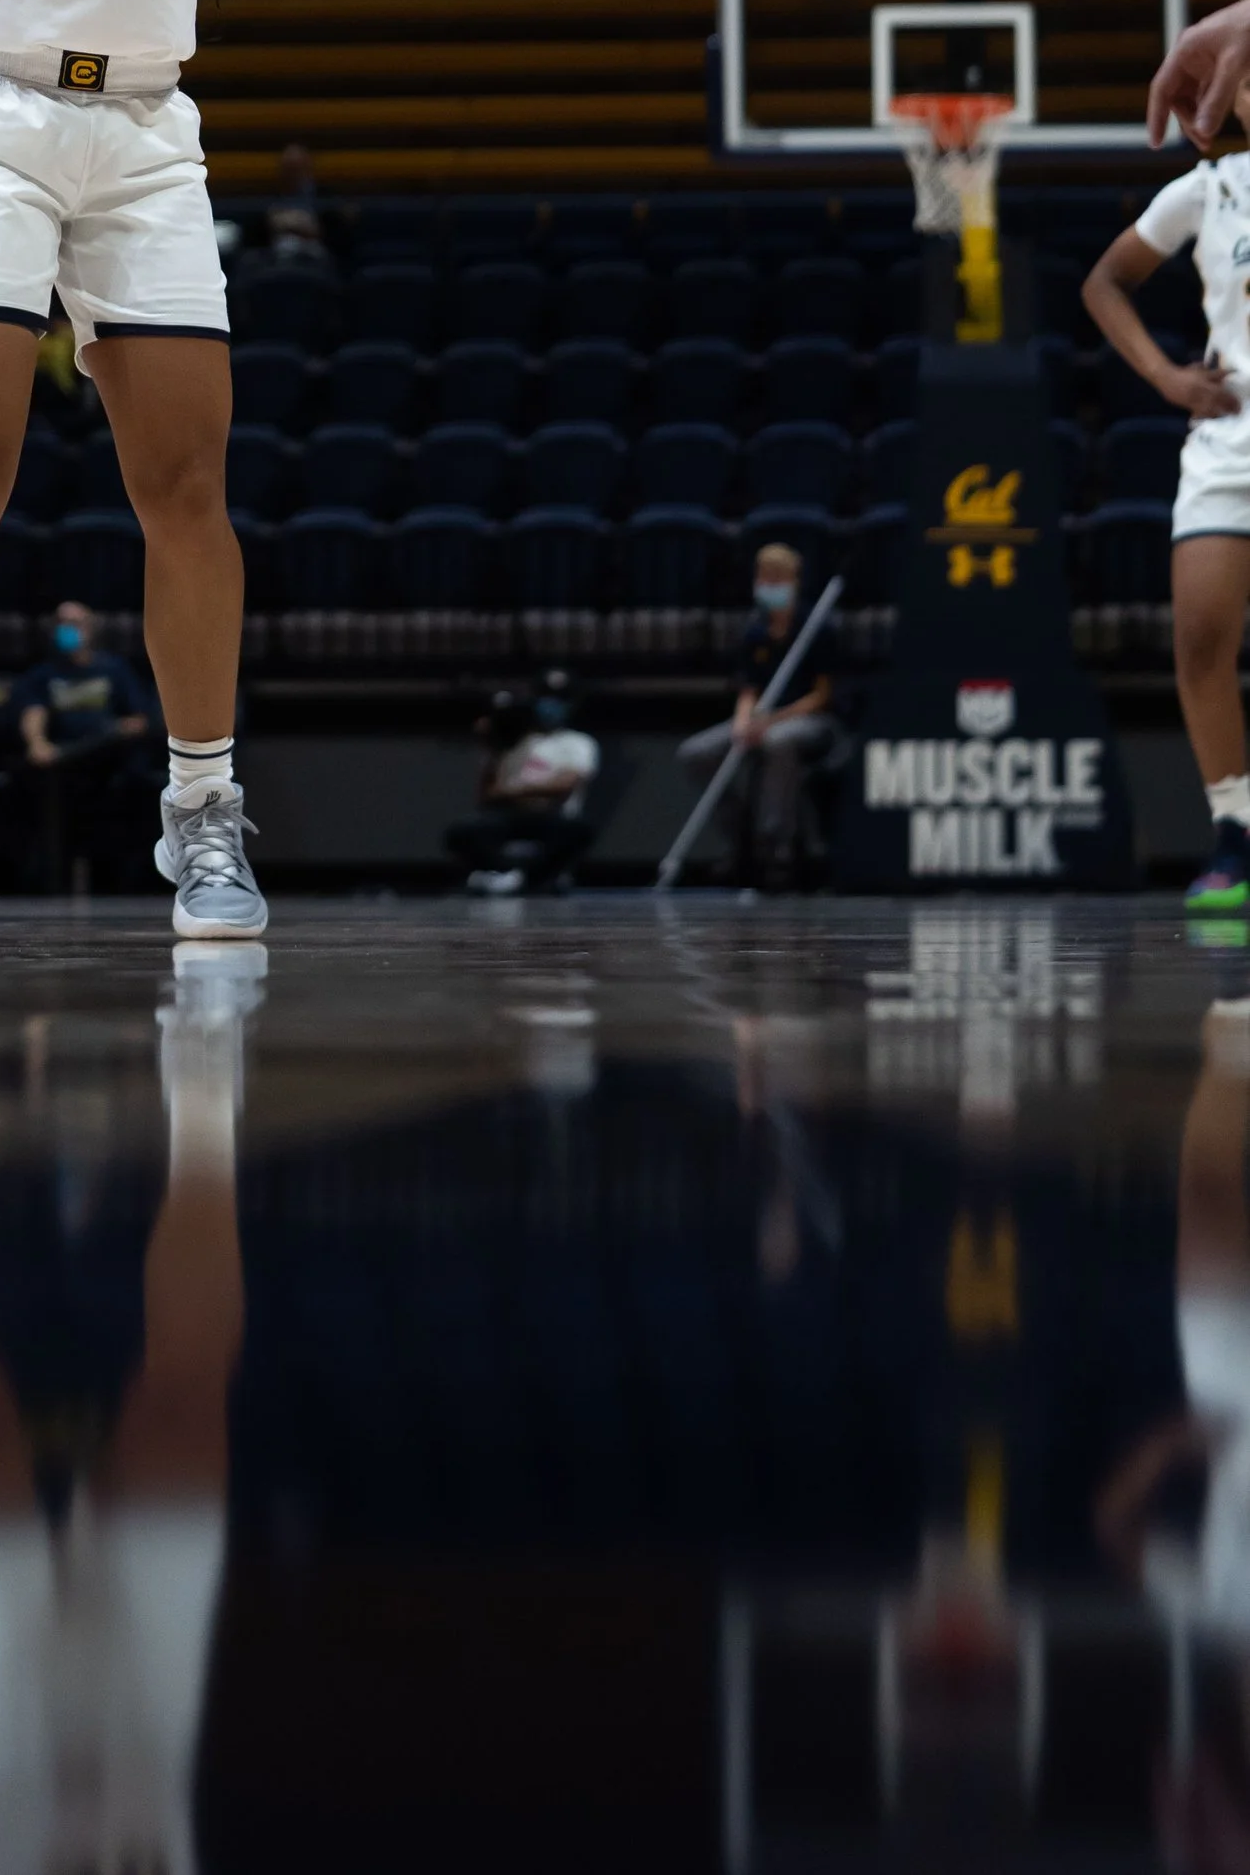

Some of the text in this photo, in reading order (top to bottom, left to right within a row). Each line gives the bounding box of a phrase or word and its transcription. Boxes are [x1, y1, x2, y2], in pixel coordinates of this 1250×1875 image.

[944, 463, 1023, 524] Cal
[864, 737, 1104, 809] MUSCLE
[908, 807, 1062, 878] MILK
